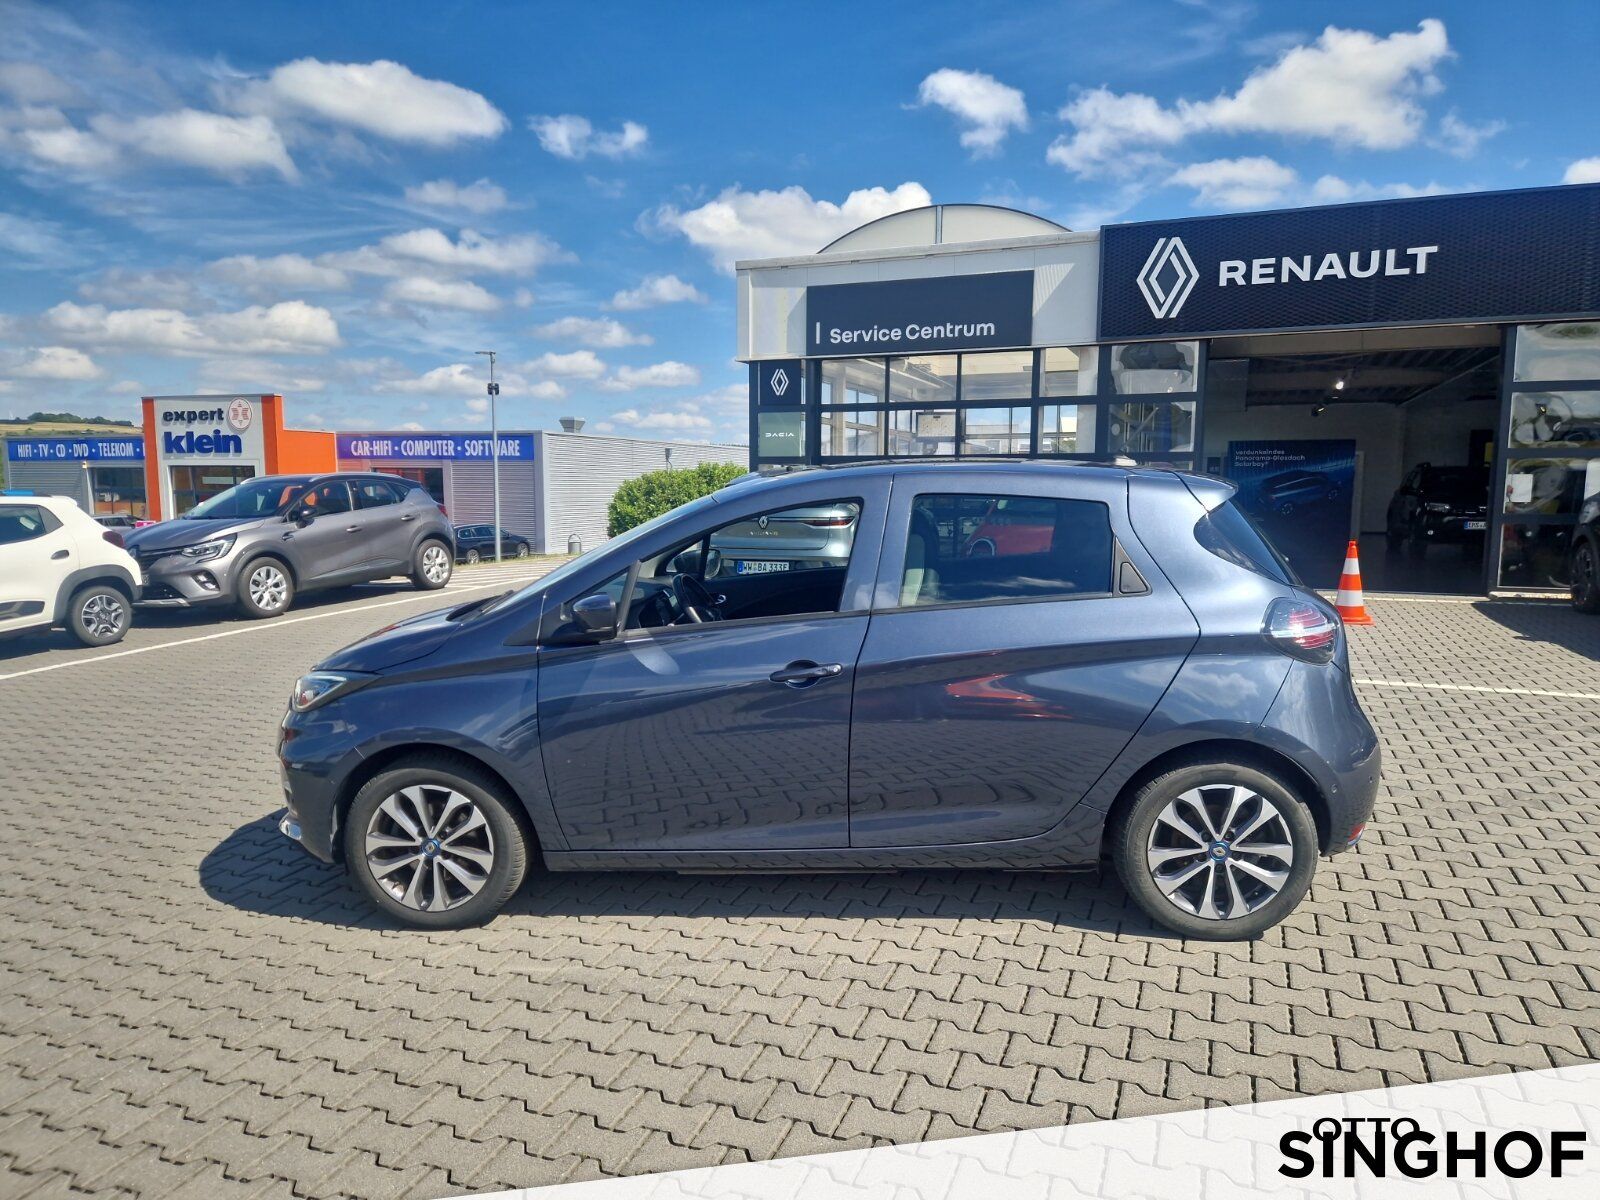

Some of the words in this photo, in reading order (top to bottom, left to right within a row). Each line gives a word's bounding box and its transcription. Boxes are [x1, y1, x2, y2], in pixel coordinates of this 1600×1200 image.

[1219, 245, 1438, 287] RENAULT
[830, 325, 901, 344] Service
[905, 322, 995, 340] Centrum
[163, 408, 224, 423] expert
[17, 444, 32, 457] HIFI
[38, 444, 49, 457] TV
[55, 444, 66, 457] CD
[73, 443, 89, 457] DVD
[98, 443, 134, 457] TELEKOM
[163, 429, 242, 453] klein
[351, 440, 392, 456] CAR-HIFI
[401, 440, 455, 456] COMPUTER
[464, 440, 520, 456] SOFTWARE
